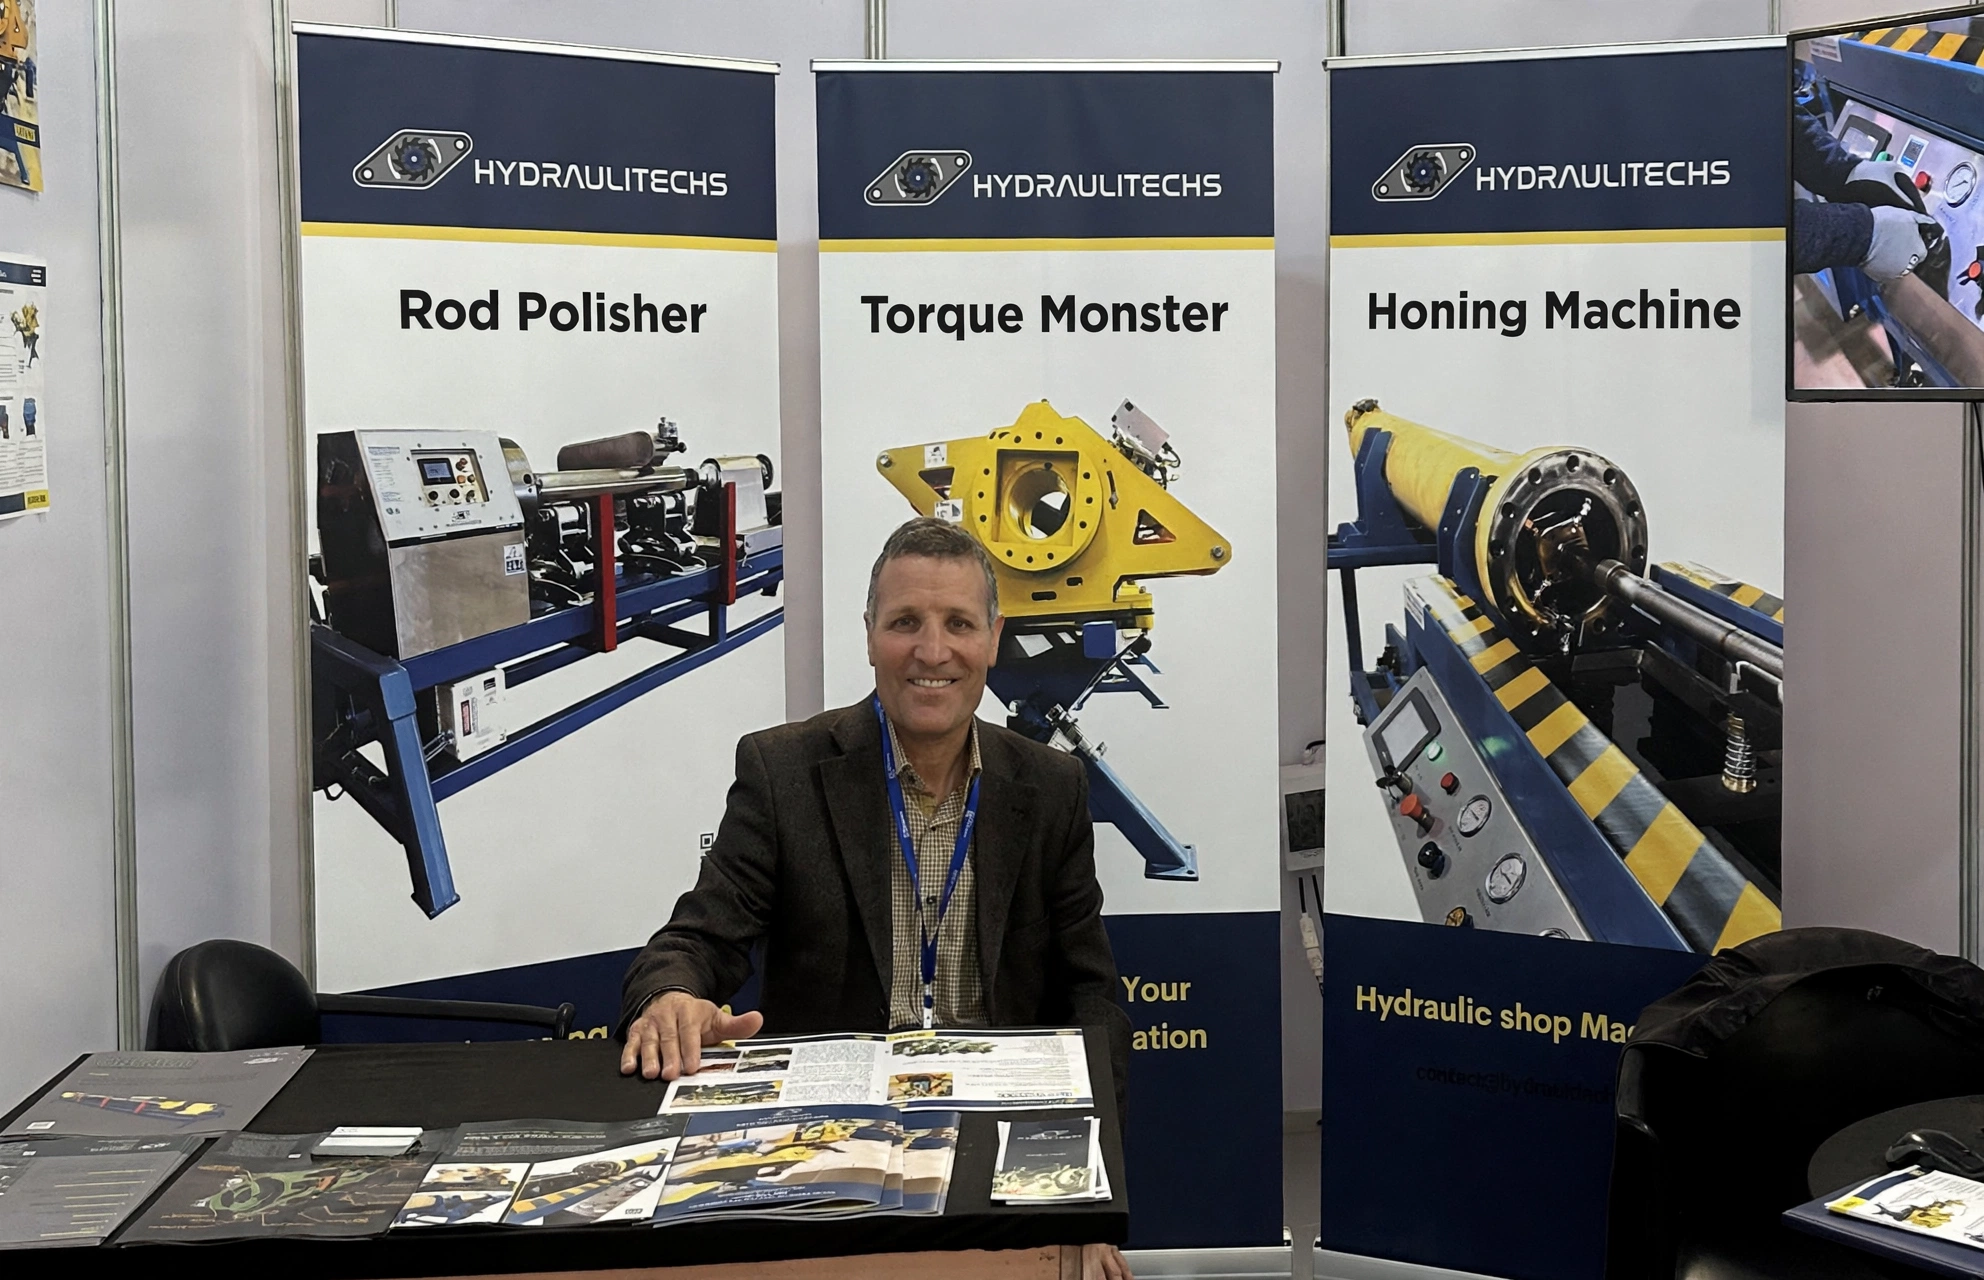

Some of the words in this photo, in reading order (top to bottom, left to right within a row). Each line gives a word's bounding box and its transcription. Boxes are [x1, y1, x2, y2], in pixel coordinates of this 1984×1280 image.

[474, 159, 728, 196] HYDRAULITECHS
[973, 173, 1222, 198] HYDRAULITECHS
[1476, 160, 1731, 191] HYDRAULITECHS
[400, 289, 499, 331] Rod
[518, 291, 707, 334] Polisher
[860, 295, 1023, 341] Torque
[1041, 294, 1229, 332] Monster
[1368, 290, 1527, 338] Honing
[1545, 288, 1741, 330] Machine
[1121, 976, 1192, 1003] Your
[1356, 984, 1492, 1026] Hydraulic
[1500, 1002, 1572, 1044] shop
[1132, 1022, 1208, 1051] ation
